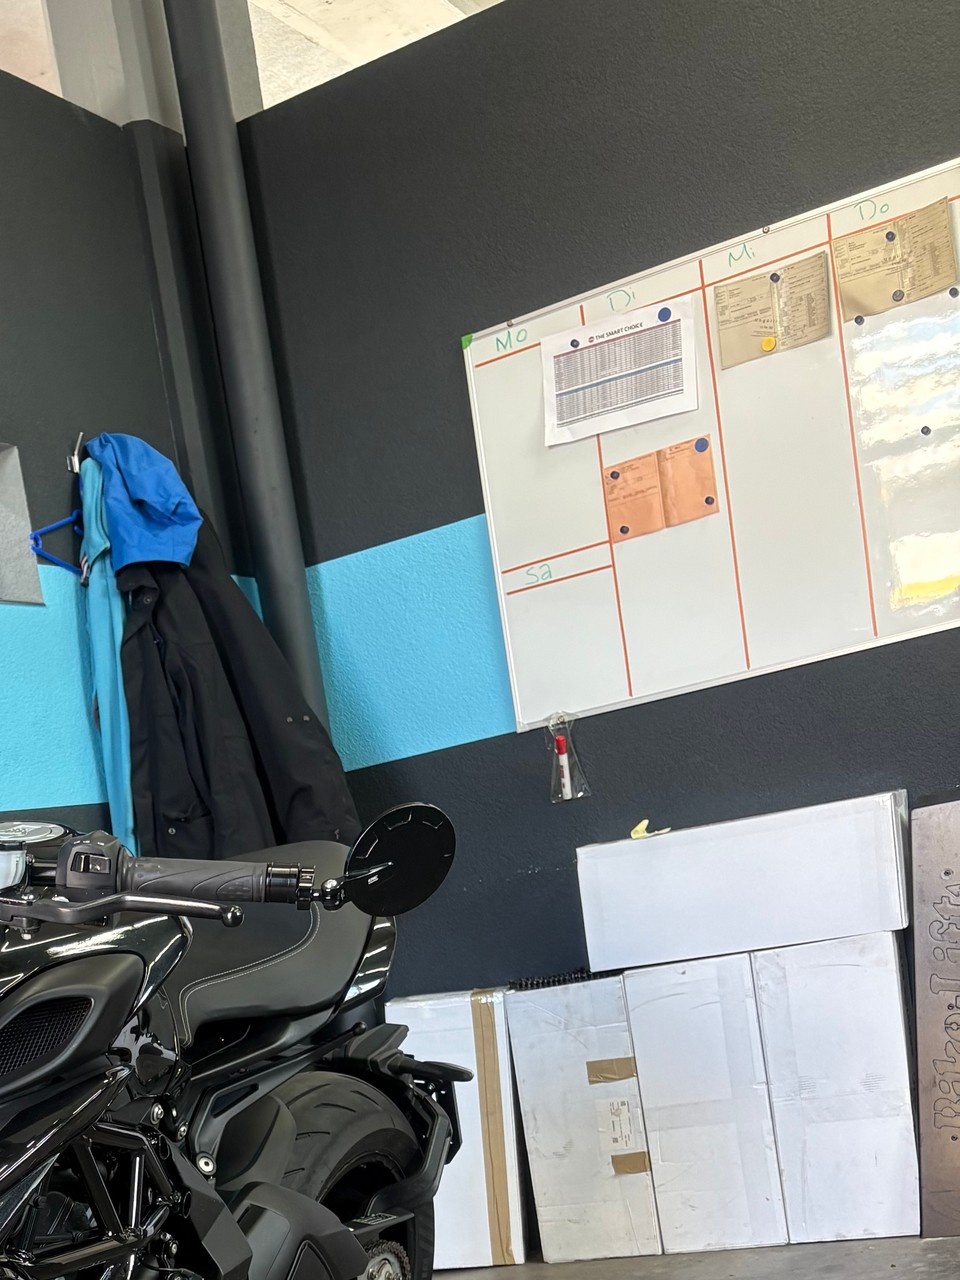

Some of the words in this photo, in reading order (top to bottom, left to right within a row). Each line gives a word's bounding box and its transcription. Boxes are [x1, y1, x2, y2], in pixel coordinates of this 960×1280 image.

[853, 199, 889, 220] Do
[727, 243, 755, 268] Mi
[606, 286, 636, 311] Di
[495, 328, 527, 352] Mo
[595, 333, 605, 341] THE
[606, 327, 624, 338] SMART
[624, 322, 643, 332] CHOICE
